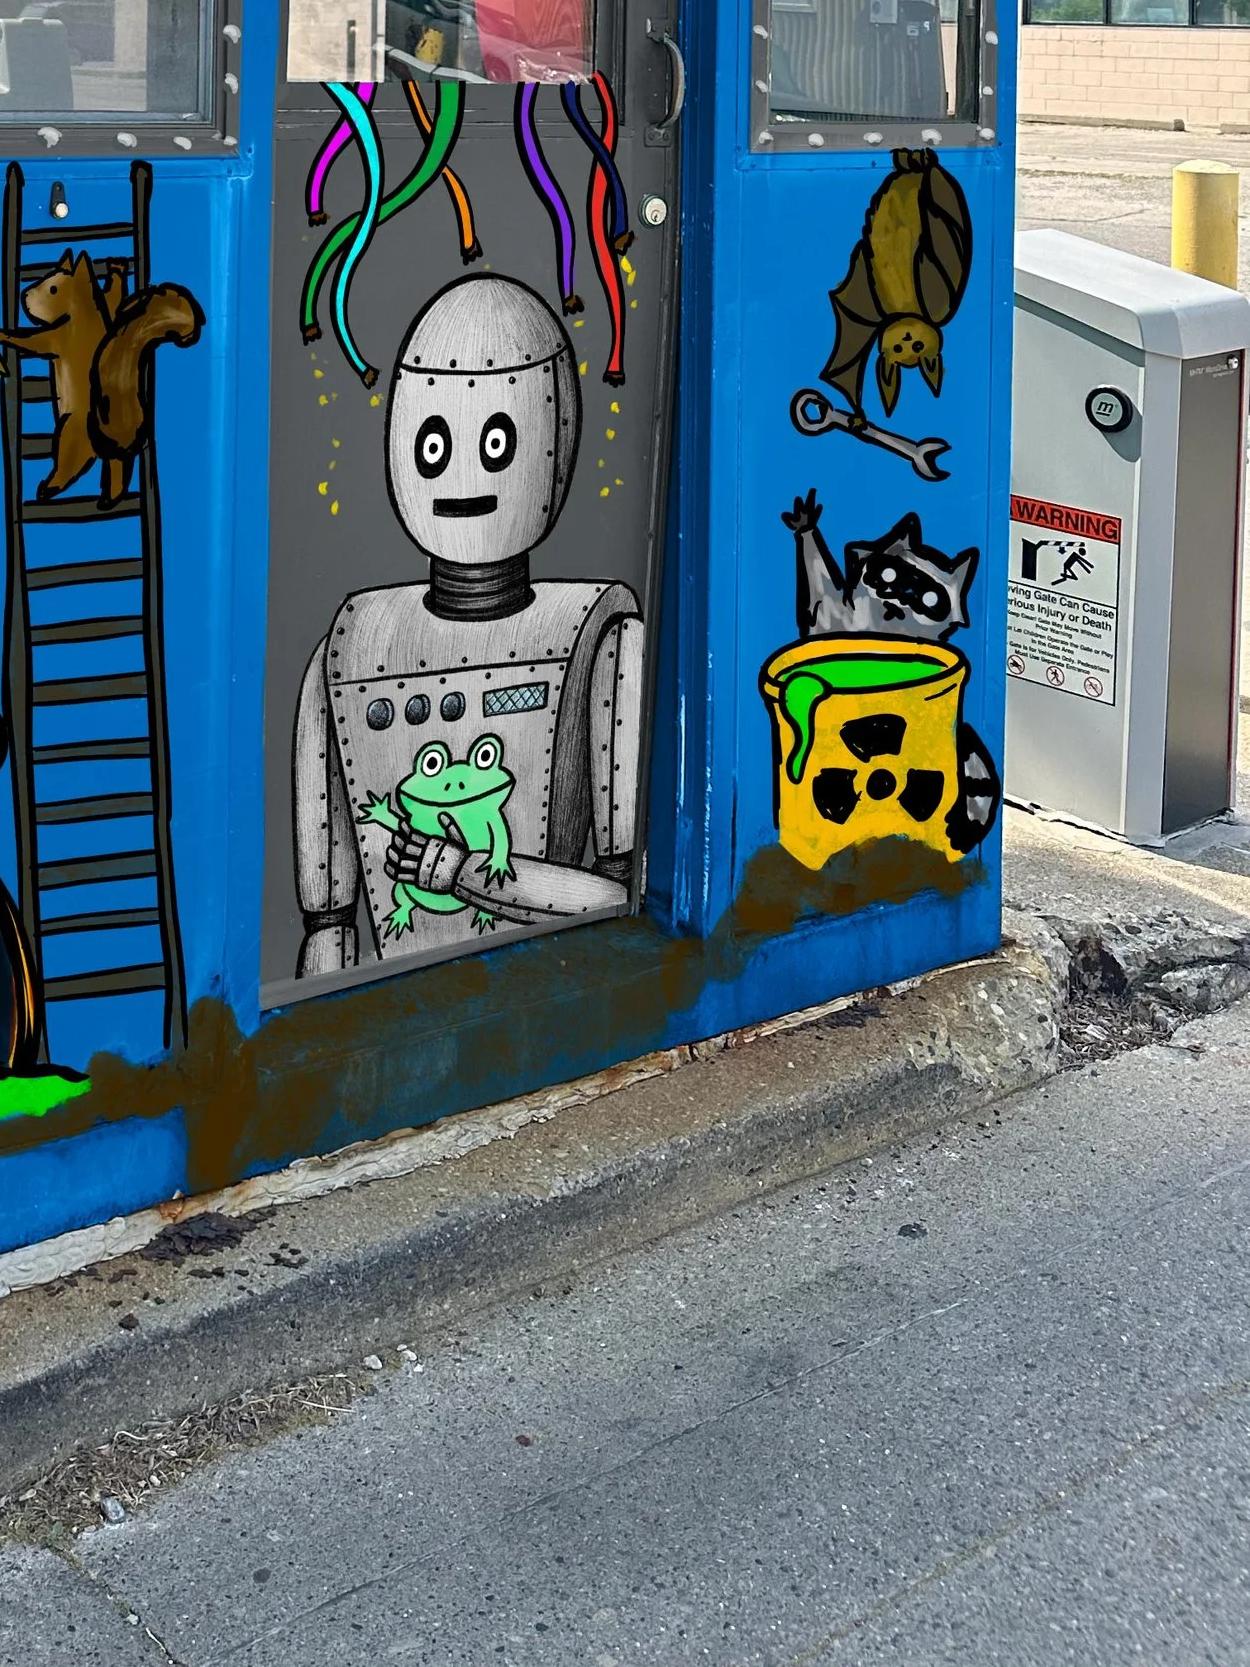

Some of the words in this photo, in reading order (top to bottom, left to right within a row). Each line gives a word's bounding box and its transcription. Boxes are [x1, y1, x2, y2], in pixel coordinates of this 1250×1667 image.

[1015, 499, 1118, 540] WARNING
[1007, 585, 1031, 599] ving
[1034, 590, 1057, 604] Gate
[1059, 597, 1080, 610] Can
[1082, 603, 1115, 619] Cause
[1007, 597, 1035, 611] rious
[1038, 603, 1066, 621] Injury
[1068, 613, 1079, 622] or
[1082, 615, 1112, 631] Death
